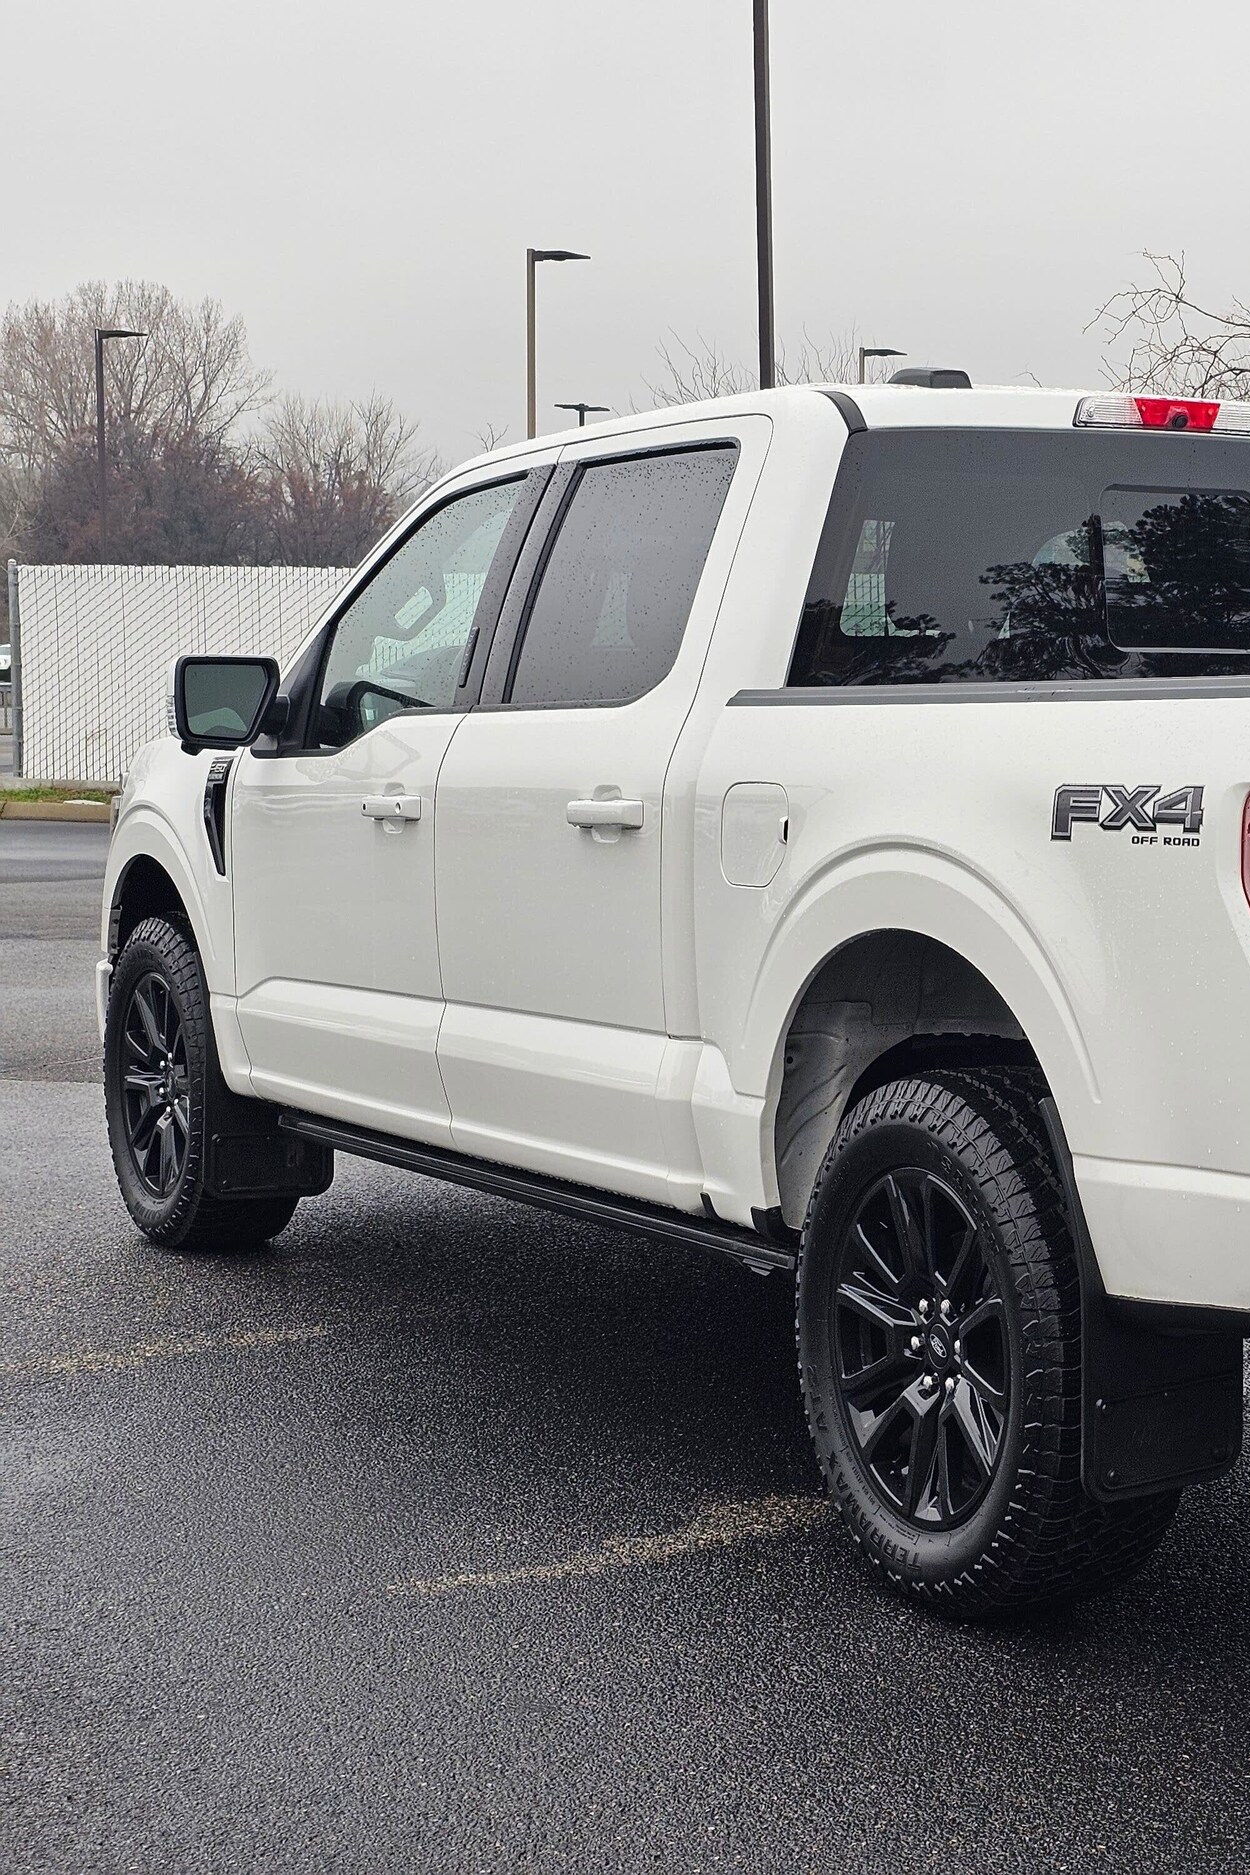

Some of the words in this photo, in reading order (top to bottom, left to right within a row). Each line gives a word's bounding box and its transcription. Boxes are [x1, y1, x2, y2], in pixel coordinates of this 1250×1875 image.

[1051, 784, 1204, 841] FX4
[1131, 836, 1158, 845] OFF
[1163, 837, 1200, 847] ROAD
[826, 1450, 922, 1571] TERRAMAX
